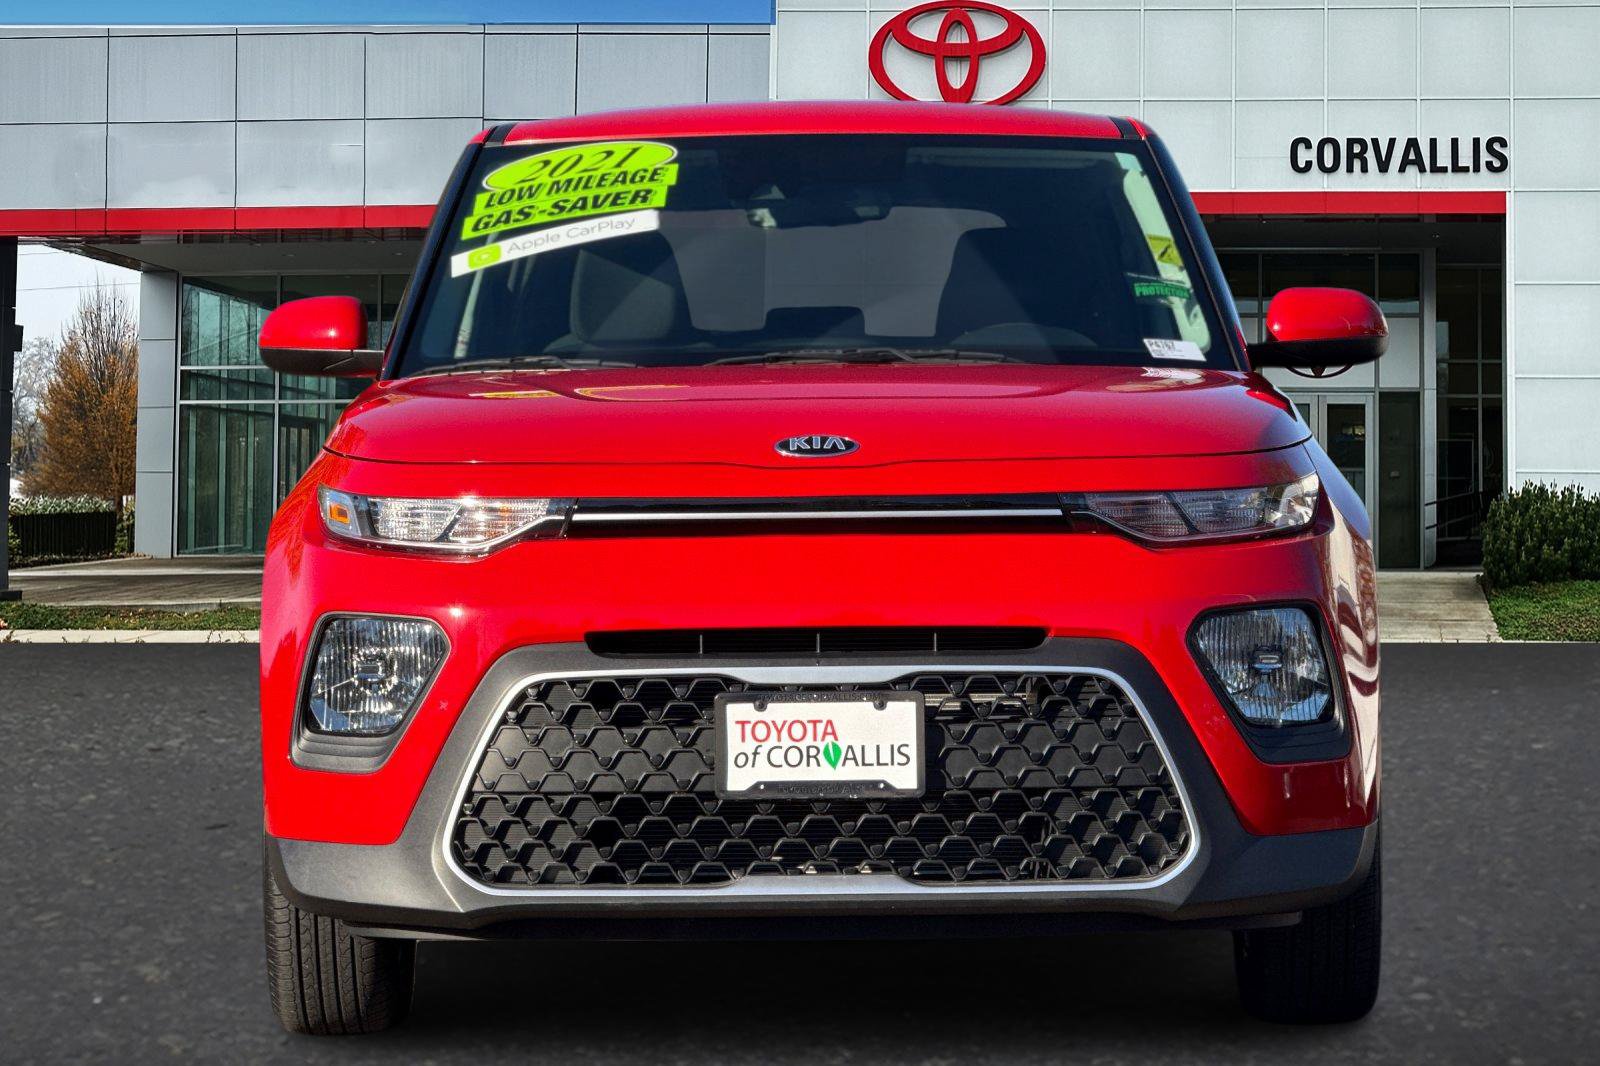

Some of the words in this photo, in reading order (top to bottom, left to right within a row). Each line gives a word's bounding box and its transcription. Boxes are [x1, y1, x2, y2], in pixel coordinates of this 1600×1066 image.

[518, 146, 644, 184] 2021
[1289, 136, 1509, 173] CORVALLIS
[484, 181, 544, 209] LOW
[546, 166, 669, 196] MILEAGE
[506, 226, 561, 254] Apple
[566, 216, 636, 240] CarPlay
[789, 435, 846, 451] KIA
[735, 719, 839, 743] TOYOTA
[733, 744, 763, 768] of
